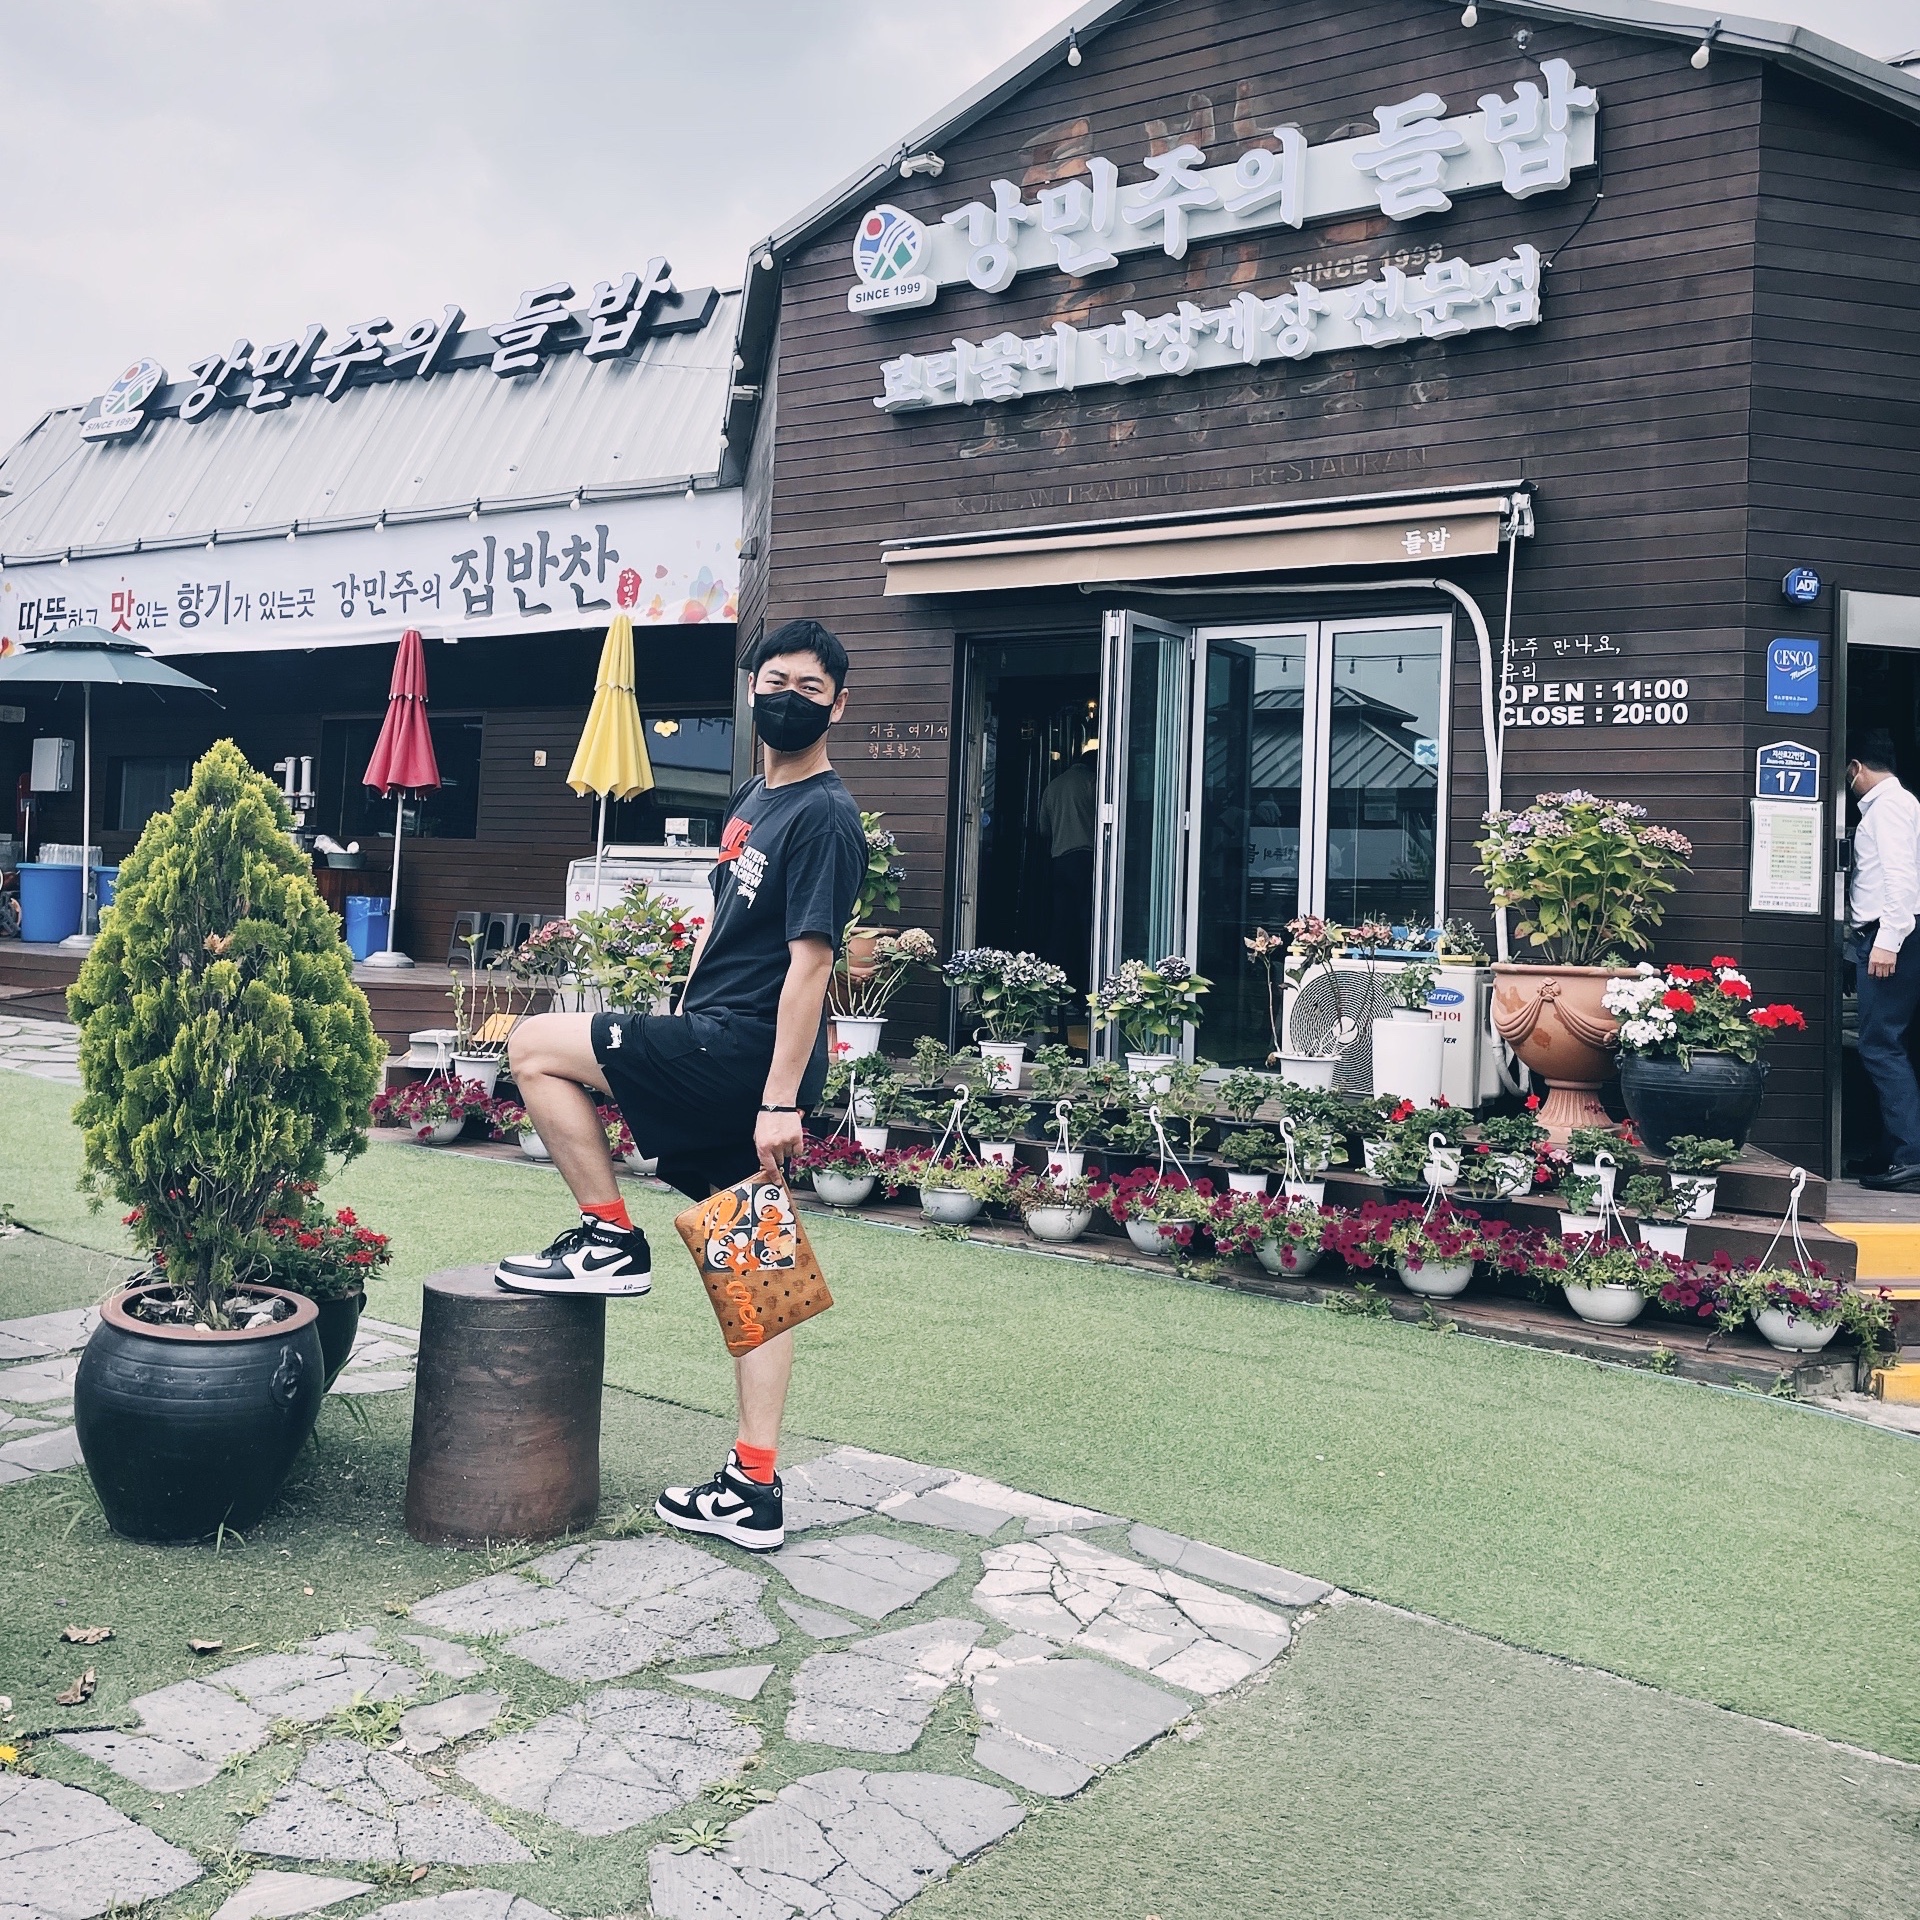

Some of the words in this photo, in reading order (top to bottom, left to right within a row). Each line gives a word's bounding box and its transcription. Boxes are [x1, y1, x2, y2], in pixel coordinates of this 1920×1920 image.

[941, 127, 1308, 293] 강민주의
[1351, 57, 1599, 221] 들밥
[1289, 254, 1370, 286] SINCE
[1379, 242, 1444, 269] 1999
[855, 288, 890, 303] SINCE
[893, 282, 921, 296] 1999
[872, 322, 1079, 408] 보리굴비
[1090, 281, 1331, 384] 간장게장
[1343, 243, 1542, 348] 전문점
[179, 303, 464, 420] 강민주의
[487, 256, 674, 375] 들밥
[86, 420, 114, 431] SINCE
[115, 416, 136, 427] 1999
[1400, 526, 1451, 555] 들밥
[110, 588, 169, 633] 맛있는
[177, 580, 252, 628] 향기가
[258, 588, 316, 620] 있는곳
[332, 569, 443, 619] 강민주의
[449, 524, 620, 621] 집반찬
[1796, 579, 1818, 593] ADT
[1553, 635, 1621, 656] 만나요,
[1773, 649, 1814, 667] CESCO
[1499, 682, 1585, 705] OPEN
[1611, 679, 1689, 701] 11:00
[1499, 705, 1585, 726] CLOSE
[1612, 702, 1689, 725] 20:00
[908, 722, 948, 739] 여기서
[1775, 770, 1801, 793] 17
[1430, 1010, 1461, 1022] 리어
